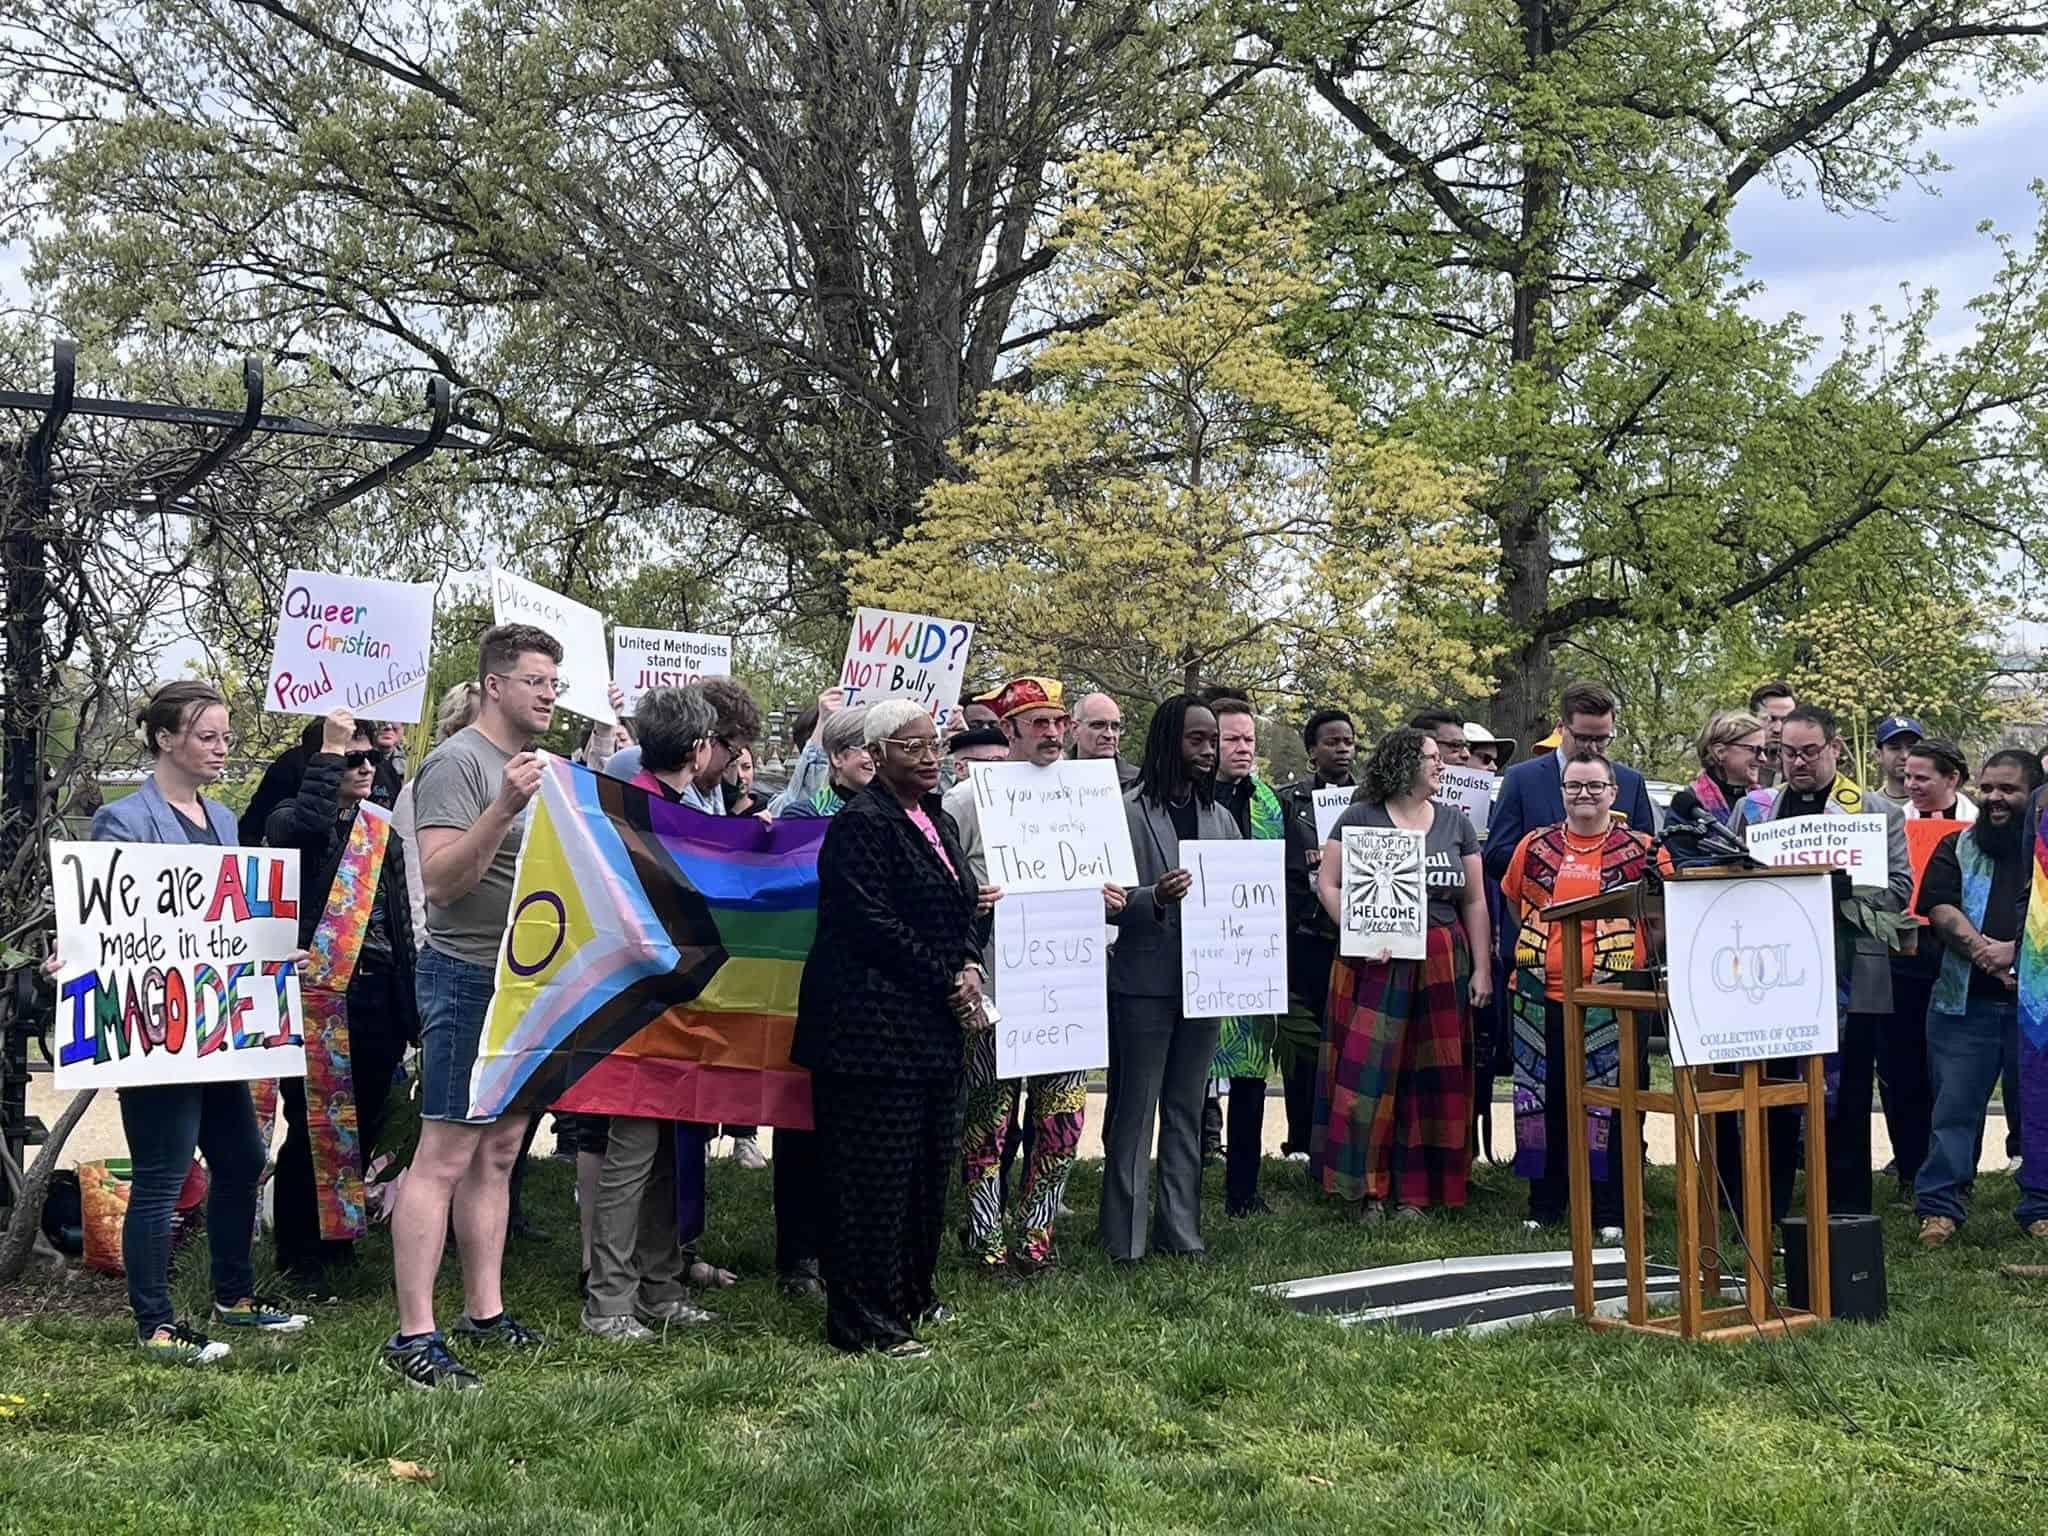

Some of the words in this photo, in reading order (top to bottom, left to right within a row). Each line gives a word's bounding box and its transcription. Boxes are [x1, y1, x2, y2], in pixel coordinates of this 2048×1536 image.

[285, 586, 367, 624] Queer
[307, 623, 391, 659] Christian
[619, 635, 660, 651] United
[664, 639, 727, 657] Methodists
[858, 614, 968, 671] WWJD?
[647, 655, 681, 668] stand
[685, 656, 702, 670] for
[274, 661, 333, 709] Proud
[346, 652, 427, 709] Unafraid
[844, 658, 888, 688] NOT
[890, 664, 936, 703] Bully
[974, 767, 998, 808] If
[1006, 785, 1032, 816] you
[1438, 773, 1490, 791] ethodists
[1446, 786, 1463, 800] for
[1317, 794, 1350, 808] Unite
[1751, 825, 1796, 844] United
[1800, 820, 1883, 835] Methodists
[1781, 836, 1823, 850] stand
[1827, 834, 1848, 847] for
[991, 844, 1047, 884] The
[1058, 840, 1113, 881] Devil
[1426, 871, 1466, 887] ans
[61, 848, 140, 925] We
[157, 866, 205, 917] are
[203, 853, 298, 923] ALL
[1198, 852, 1207, 908] I
[1231, 883, 1276, 909] am
[1220, 914, 1245, 941] the
[1352, 905, 1416, 920] WELCOME
[99, 917, 166, 967] made
[178, 928, 200, 960] in
[207, 924, 247, 959] the
[1003, 903, 1094, 969] Jesus
[1234, 944, 1253, 966] joy
[1263, 933, 1281, 958] of
[1041, 984, 1058, 1014] is
[1186, 970, 1280, 1014] Pentecost
[59, 966, 188, 1067] IMAGO
[1006, 1023, 1084, 1066] queer
[1700, 1029, 1768, 1047] COLLECTIVE
[1769, 1027, 1784, 1041] OF
[1786, 1024, 1820, 1042] QUEER
[1708, 1045, 1766, 1061] CHRISTIAN
[1767, 1041, 1814, 1056] LEADERS
